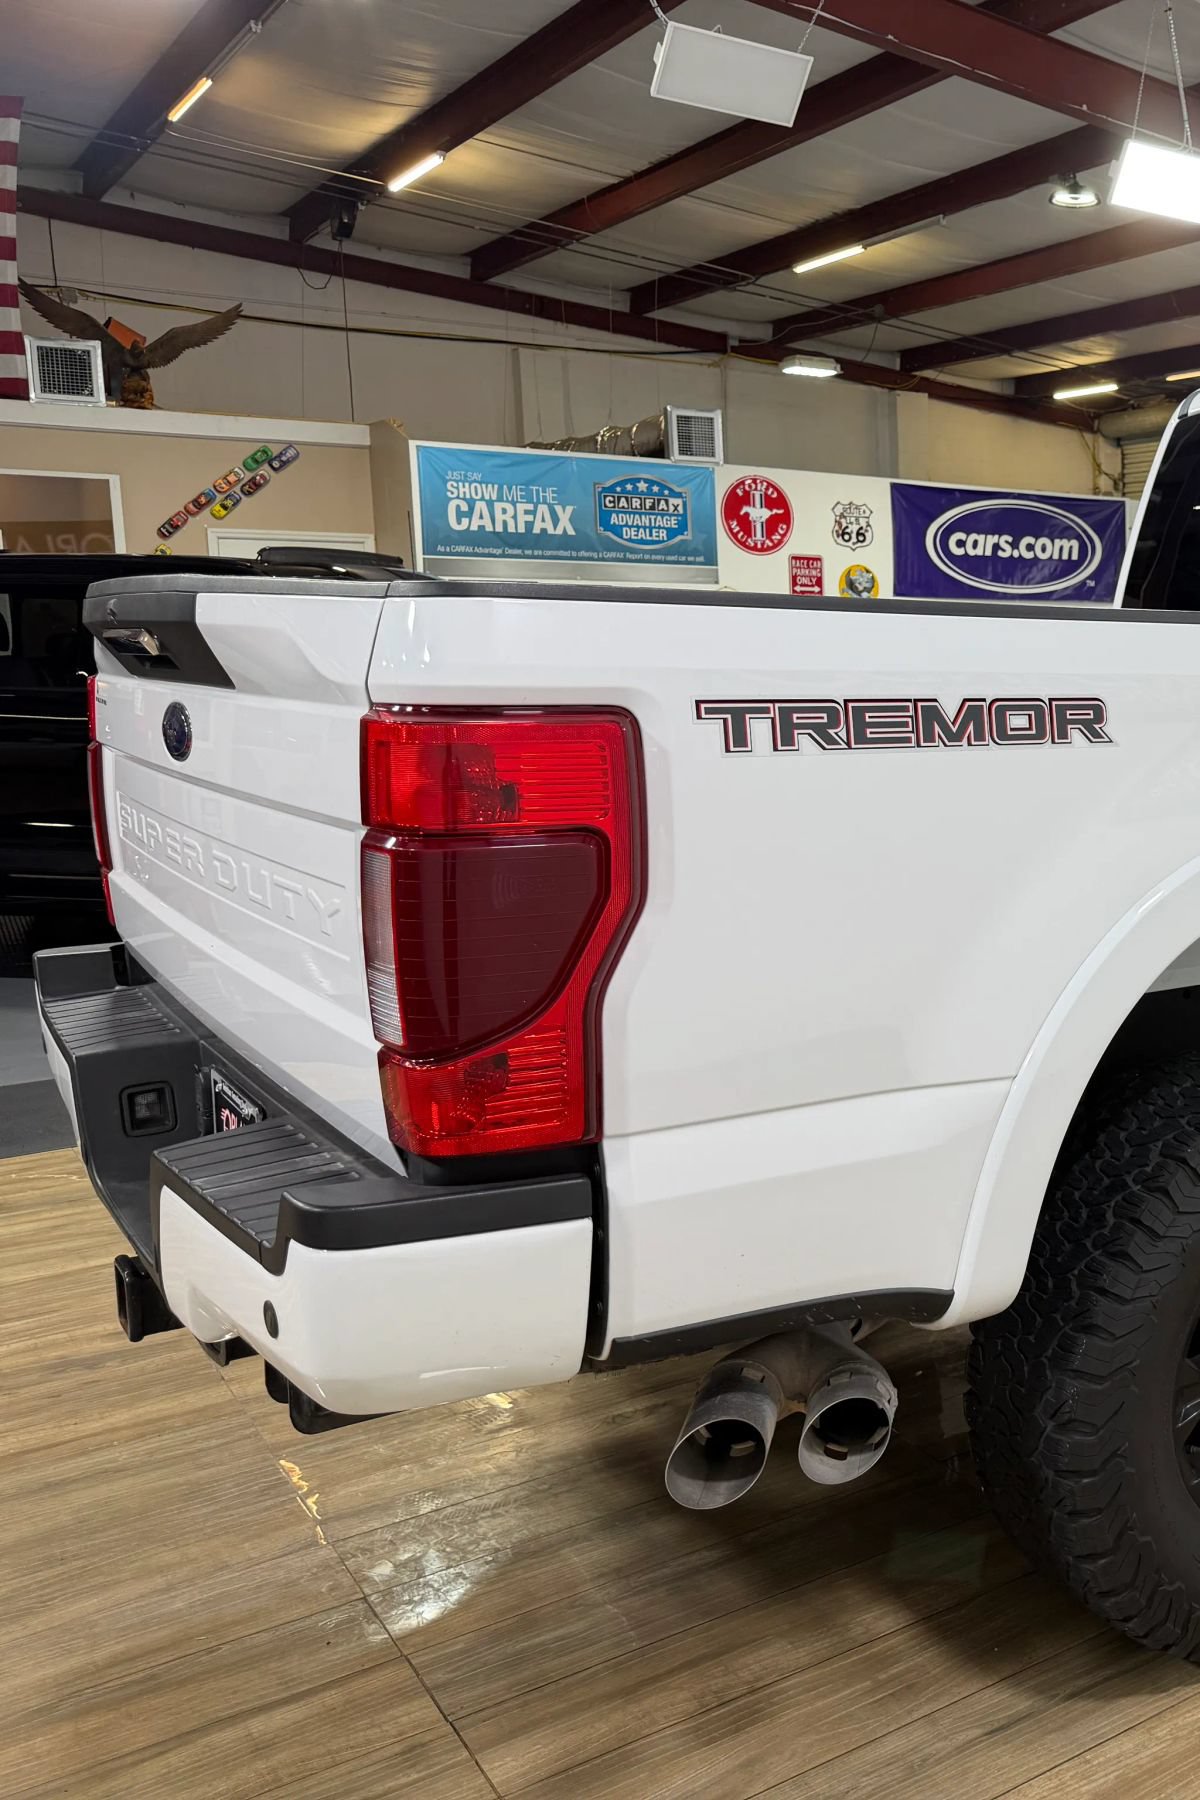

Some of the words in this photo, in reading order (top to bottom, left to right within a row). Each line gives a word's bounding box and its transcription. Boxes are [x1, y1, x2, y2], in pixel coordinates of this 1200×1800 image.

[446, 470, 465, 480] JUST
[467, 471, 482, 481] SAY
[446, 481, 499, 500] SHOW
[503, 485, 527, 502] ME
[529, 486, 558, 504] THE
[736, 479, 778, 498] FORD
[604, 495, 681, 513] CARFAX
[447, 498, 577, 536] CARFAX
[610, 513, 679, 528] ADVANTAGE
[622, 527, 668, 541] DEALER
[728, 518, 787, 549] MUSTANG
[841, 525, 867, 543] 66
[948, 531, 1080, 561] cars.com
[792, 559, 808, 569] RACE
[809, 560, 822, 569] CAR
[792, 567, 822, 577] PARKING
[796, 576, 818, 586] ONLY
[694, 697, 1115, 754] TREMOR
[119, 801, 206, 878] SUPER
[211, 848, 342, 937] DUTY
